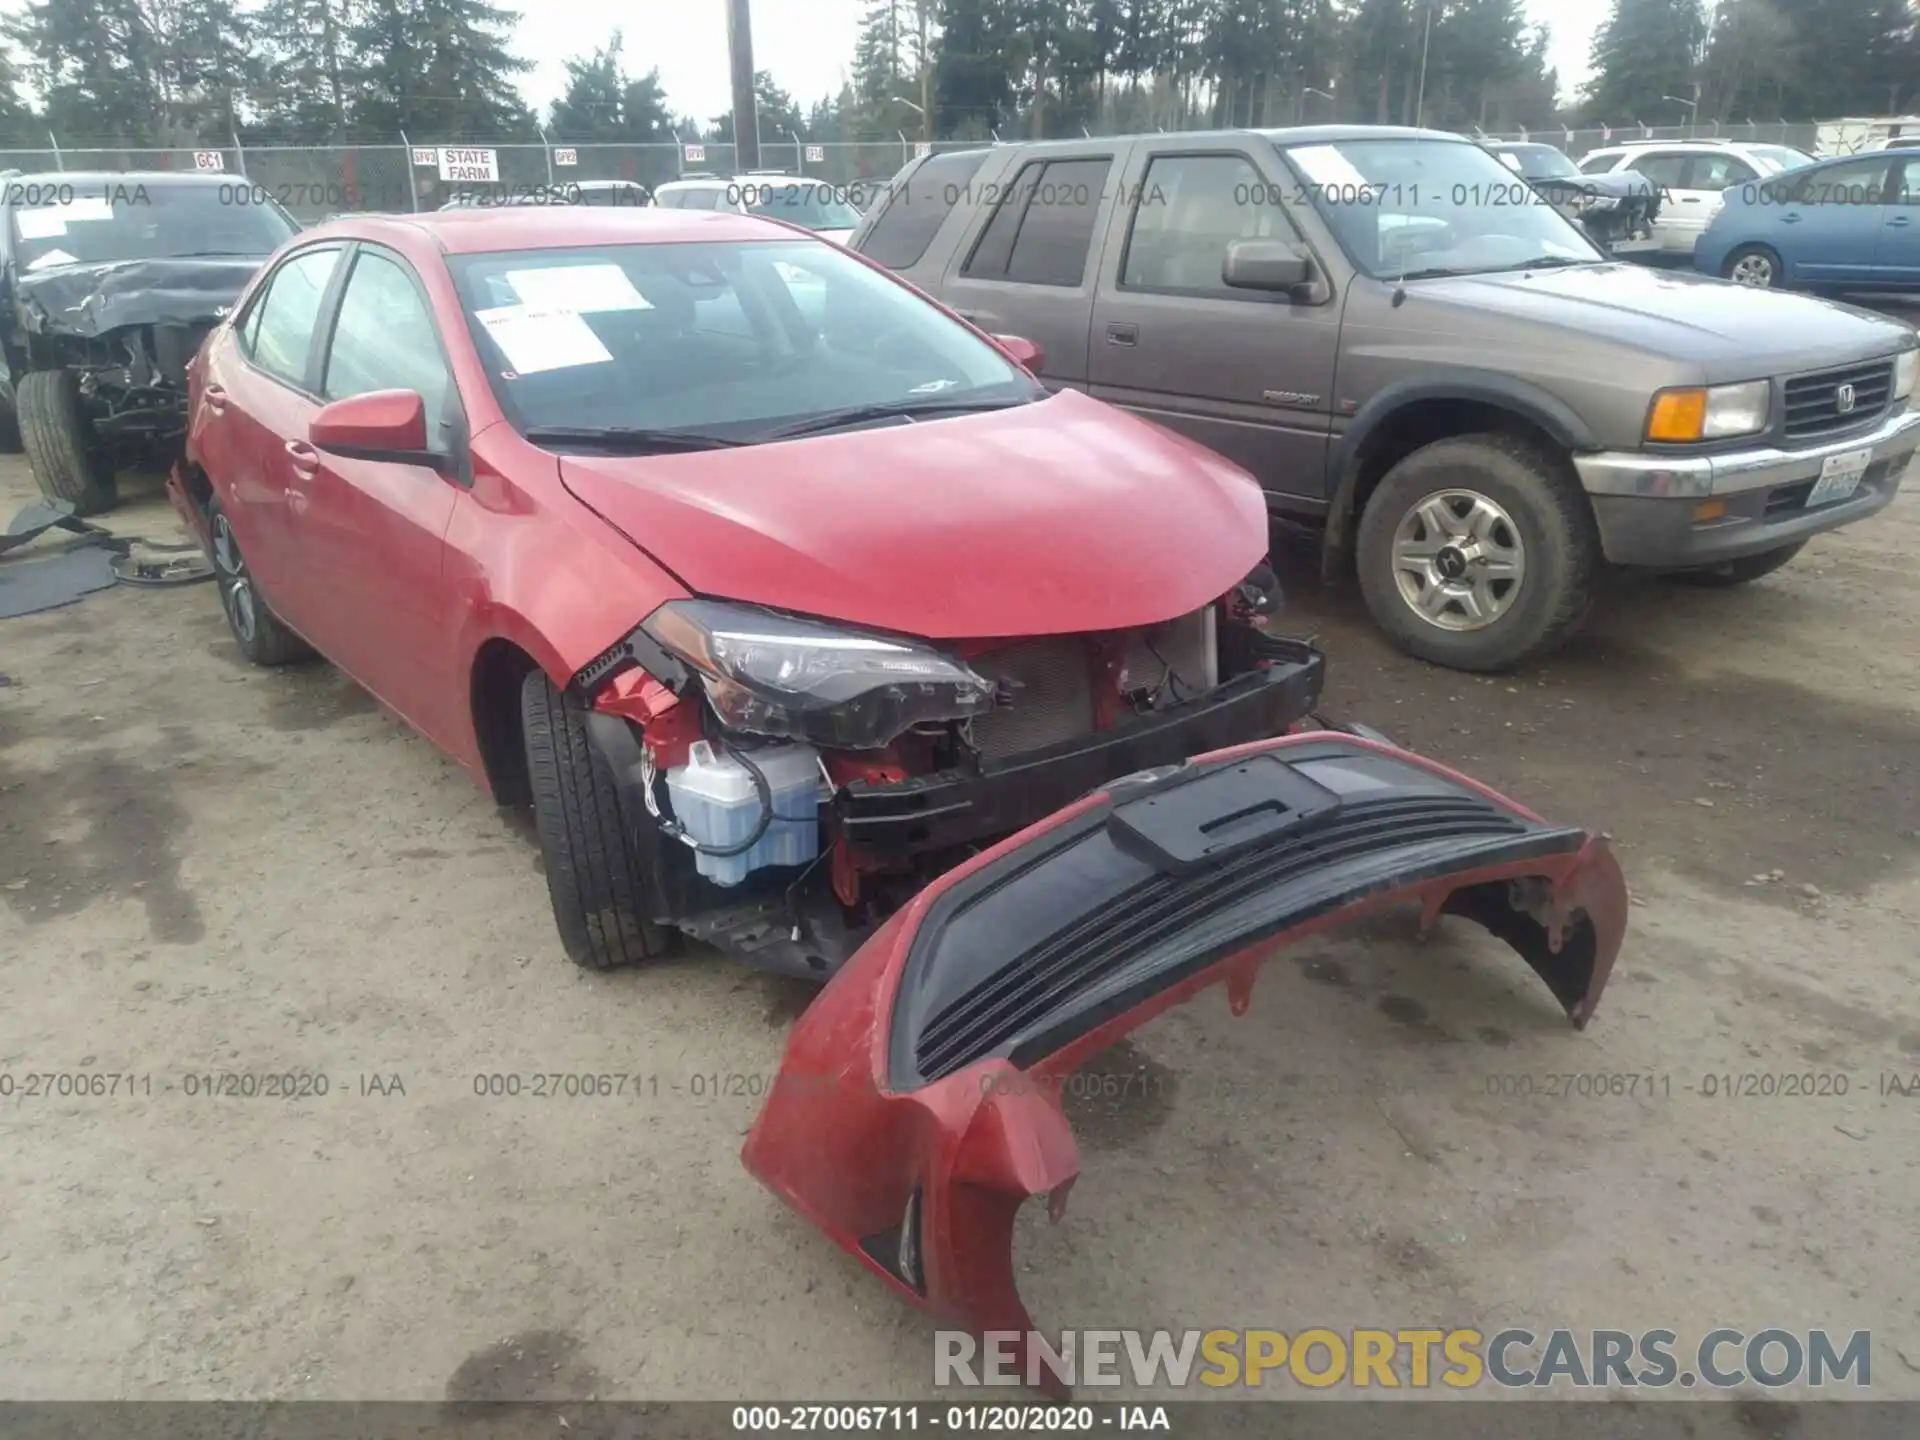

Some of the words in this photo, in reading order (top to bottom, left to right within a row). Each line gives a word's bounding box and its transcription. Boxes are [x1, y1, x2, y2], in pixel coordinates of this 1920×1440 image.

[197, 153, 221, 169] GC1
[445, 151, 491, 164] STATE
[449, 167, 491, 180] FARM
